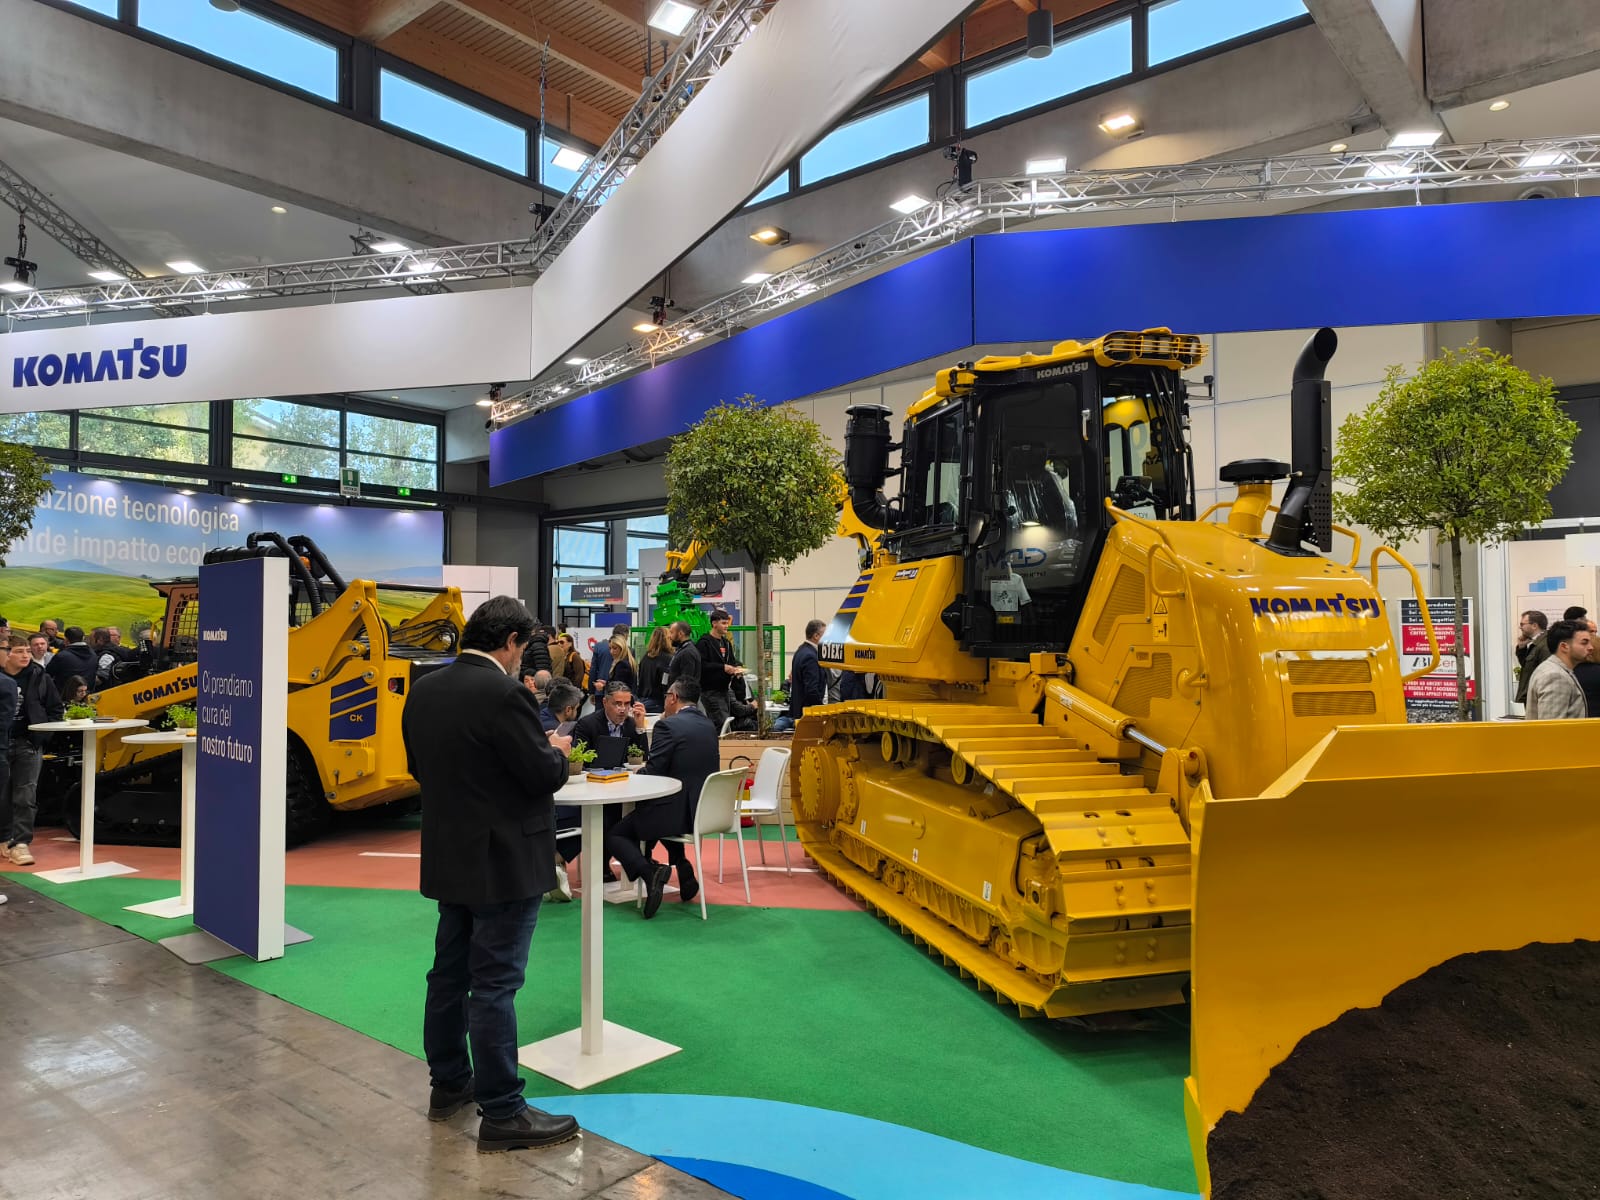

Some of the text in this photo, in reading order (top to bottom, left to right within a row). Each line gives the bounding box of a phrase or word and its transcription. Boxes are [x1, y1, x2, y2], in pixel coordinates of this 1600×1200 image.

[13, 338, 187, 388] KOMATSU
[1036, 361, 1089, 380] KOMATSU
[122, 494, 239, 534] tecnologica
[73, 529, 160, 566] impatto
[1249, 593, 1380, 619] KOMATSU
[203, 628, 228, 642] KOMATSU
[854, 648, 876, 660] KOMATSU
[132, 675, 198, 705] KOMATSU
[202, 670, 253, 699] Ci prendiamo
[202, 704, 232, 727] cura del
[349, 714, 363, 722] CK
[201, 735, 253, 764] nostro futuro
